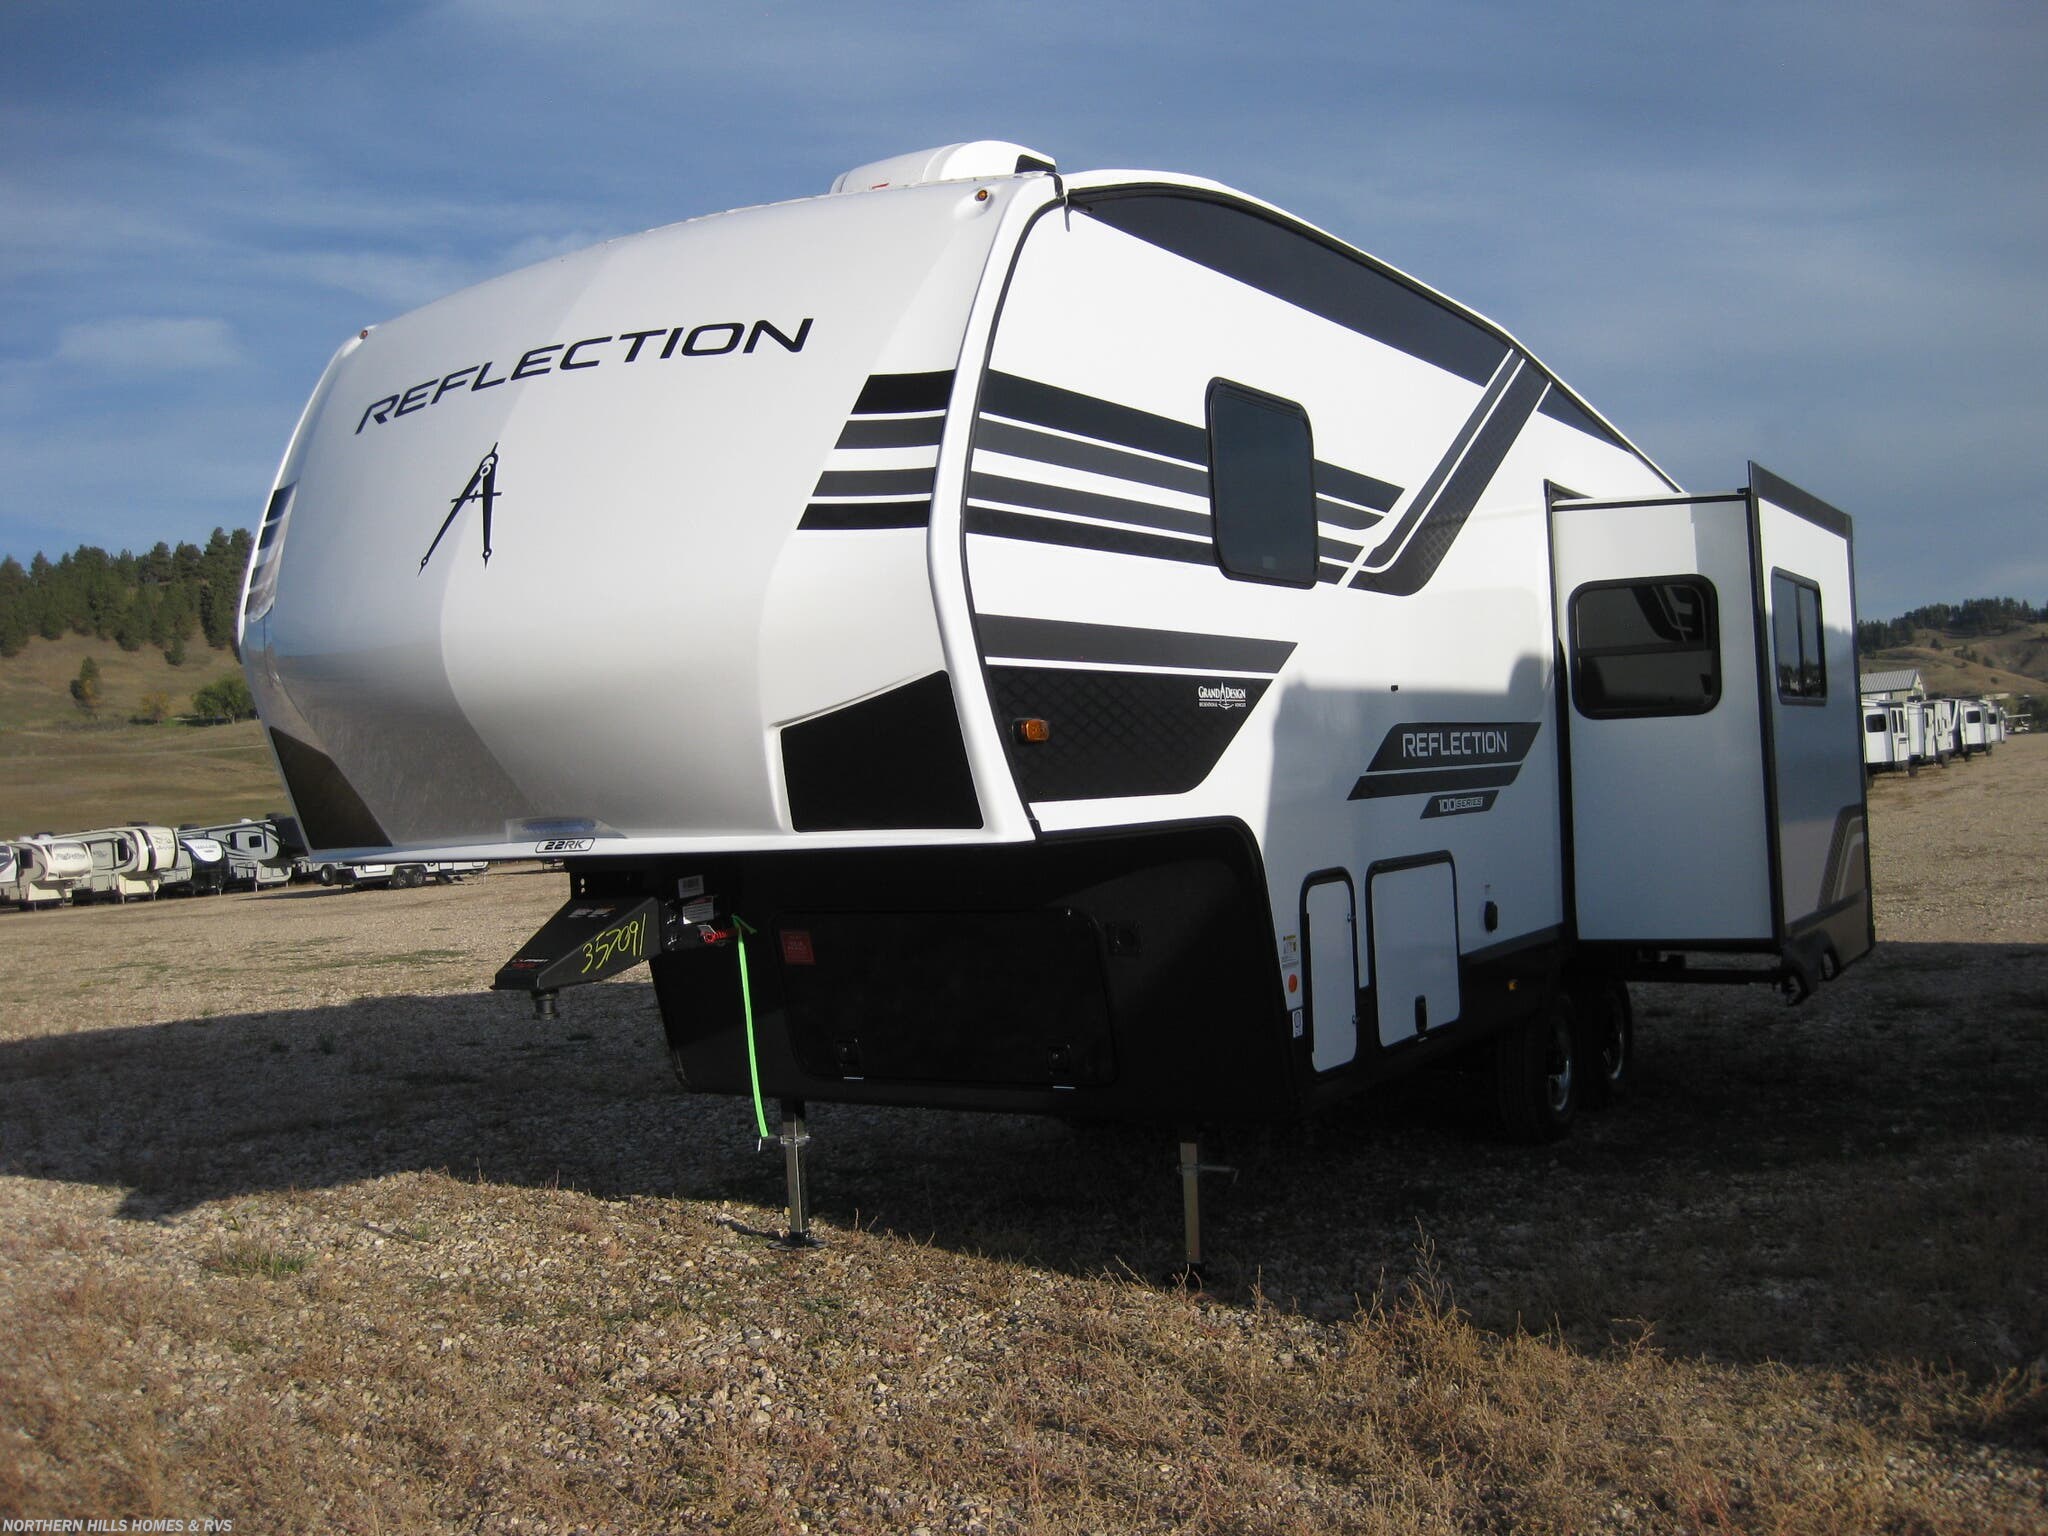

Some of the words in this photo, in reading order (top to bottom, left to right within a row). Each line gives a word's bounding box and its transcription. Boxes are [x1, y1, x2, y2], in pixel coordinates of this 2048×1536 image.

[355, 318, 814, 435] REFLECTION
[1198, 685, 1220, 699] GRAND
[1225, 686, 1246, 699] DESIGN
[1402, 730, 1508, 758] REFLECTION
[544, 840, 585, 850] 22RK
